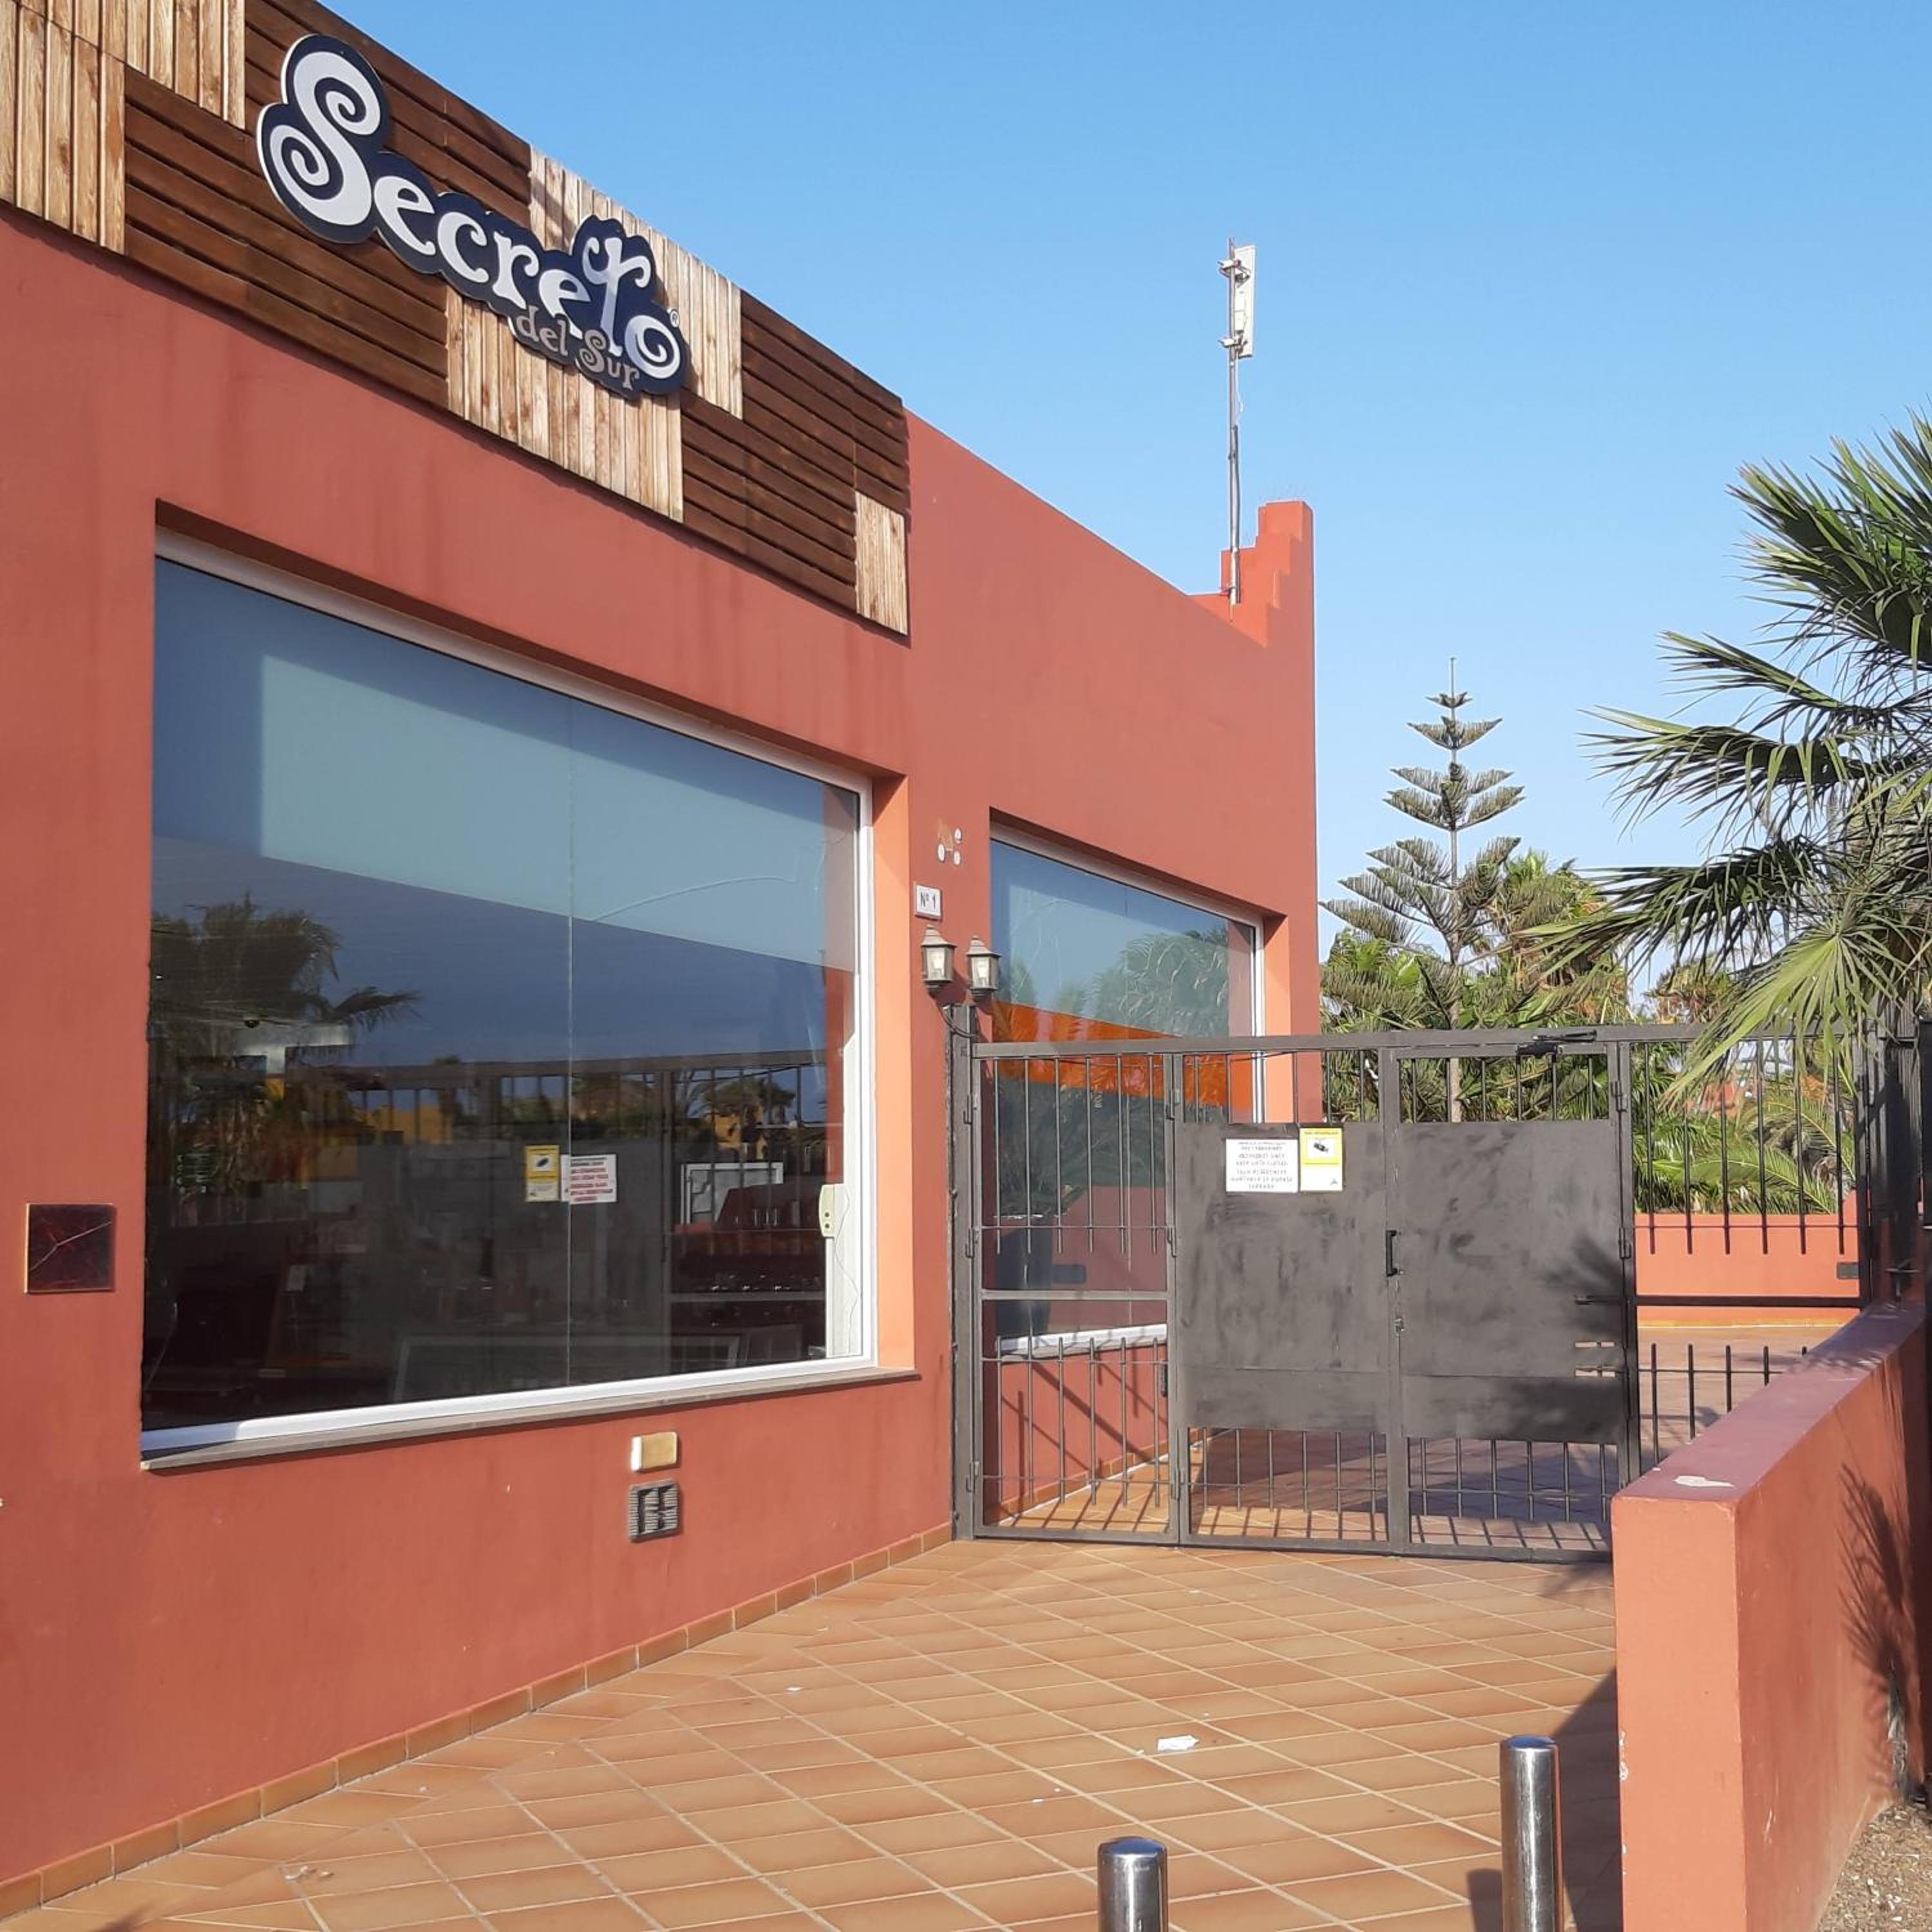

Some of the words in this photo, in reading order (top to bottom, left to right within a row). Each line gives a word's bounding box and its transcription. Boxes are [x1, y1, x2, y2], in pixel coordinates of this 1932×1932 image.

[269, 51, 680, 379] Secreto
[516, 305, 569, 356] del
[580, 329, 640, 391] Sur
